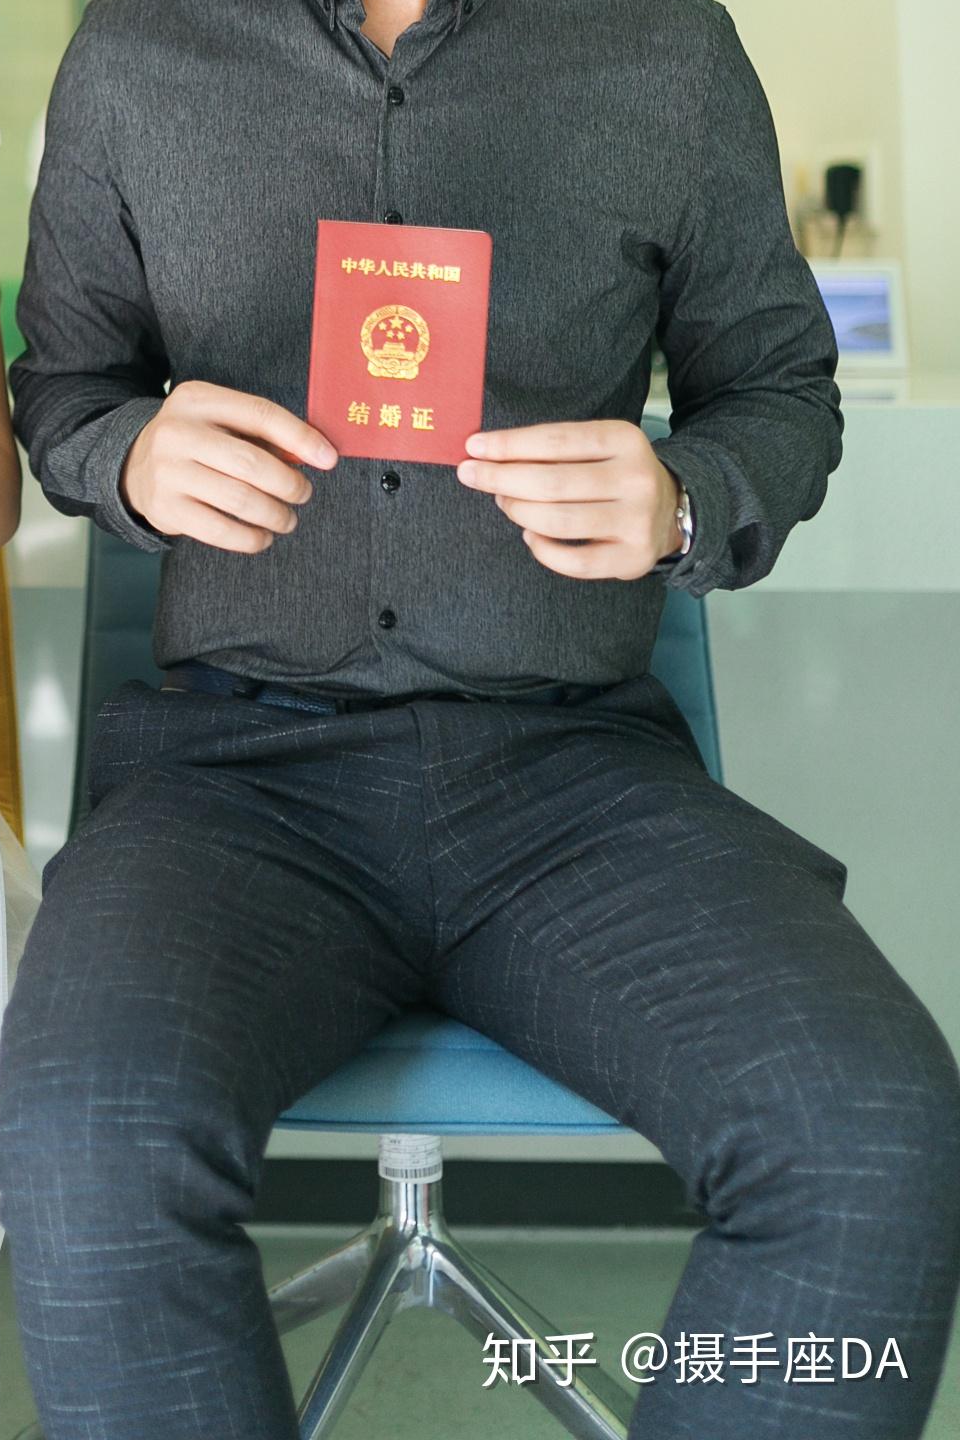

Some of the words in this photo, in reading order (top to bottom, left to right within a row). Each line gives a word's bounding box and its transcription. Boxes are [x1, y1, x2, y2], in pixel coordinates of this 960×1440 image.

[341, 257, 461, 282] 中华人民共和国
[347, 401, 435, 430] 结婚证
